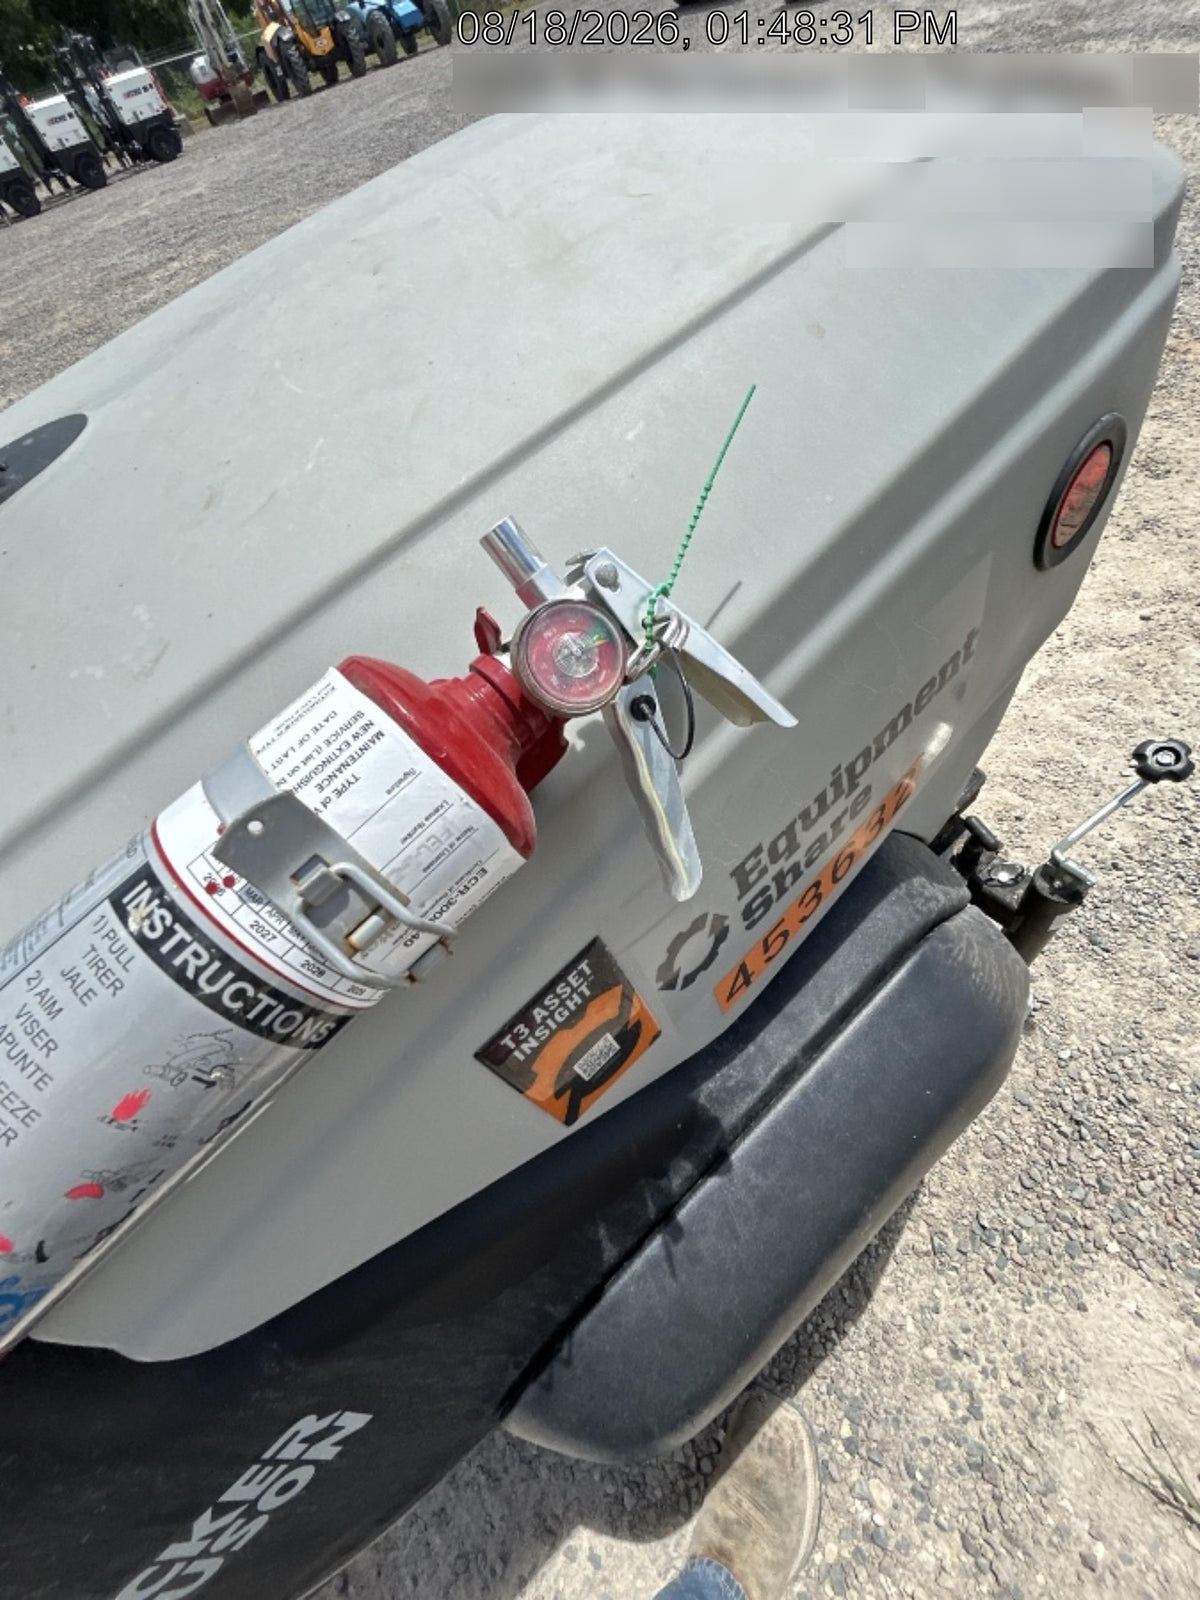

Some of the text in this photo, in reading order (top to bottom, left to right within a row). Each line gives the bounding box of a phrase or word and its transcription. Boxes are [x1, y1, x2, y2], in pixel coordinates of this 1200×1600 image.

[310, 710, 338, 734] DATE
[351, 720, 375, 741] NEW
[314, 729, 385, 793] MAINTENANCE
[332, 773, 361, 799] TYPE
[729, 627, 980, 901] Equipment
[741, 785, 872, 931] Share
[101, 924, 137, 973] PULL
[249, 920, 278, 942] 2027
[60, 966, 98, 1007] JALE
[81, 943, 125, 998] TIRER
[121, 879, 336, 1043] INSTRUCTIONS
[14, 1002, 59, 1059] VISER
[35, 987, 64, 1021] AIM
[500, 959, 593, 1051] T3 ASSET
[512, 981, 592, 1062] INSIGHT
[0, 1023, 55, 1092] APUNTE
[114, 1409, 343, 1600] CKER
